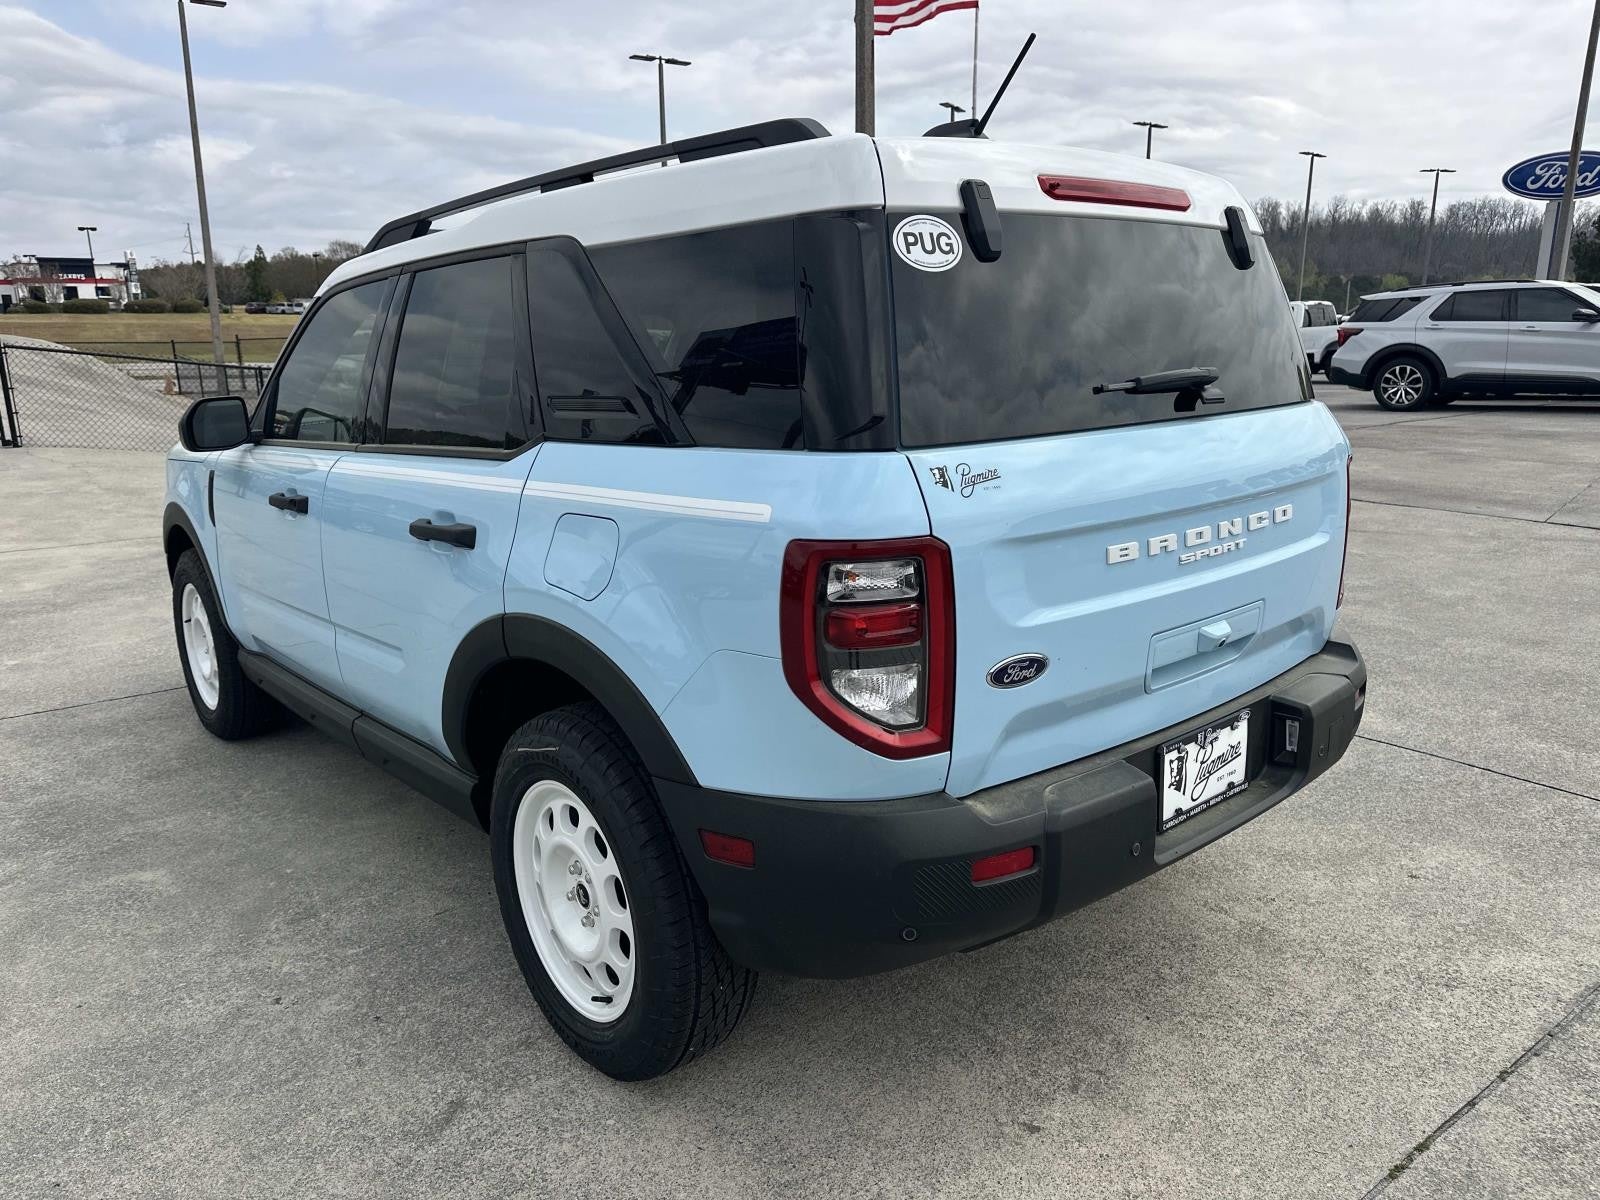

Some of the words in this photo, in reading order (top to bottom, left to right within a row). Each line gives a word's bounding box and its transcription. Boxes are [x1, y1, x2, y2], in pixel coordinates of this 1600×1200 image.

[902, 231, 955, 255] PUG
[955, 462, 1001, 498] Pugmire
[1106, 503, 1293, 565] BRONCO
[1178, 538, 1247, 565] SPORT
[1003, 660, 1038, 683] Ford
